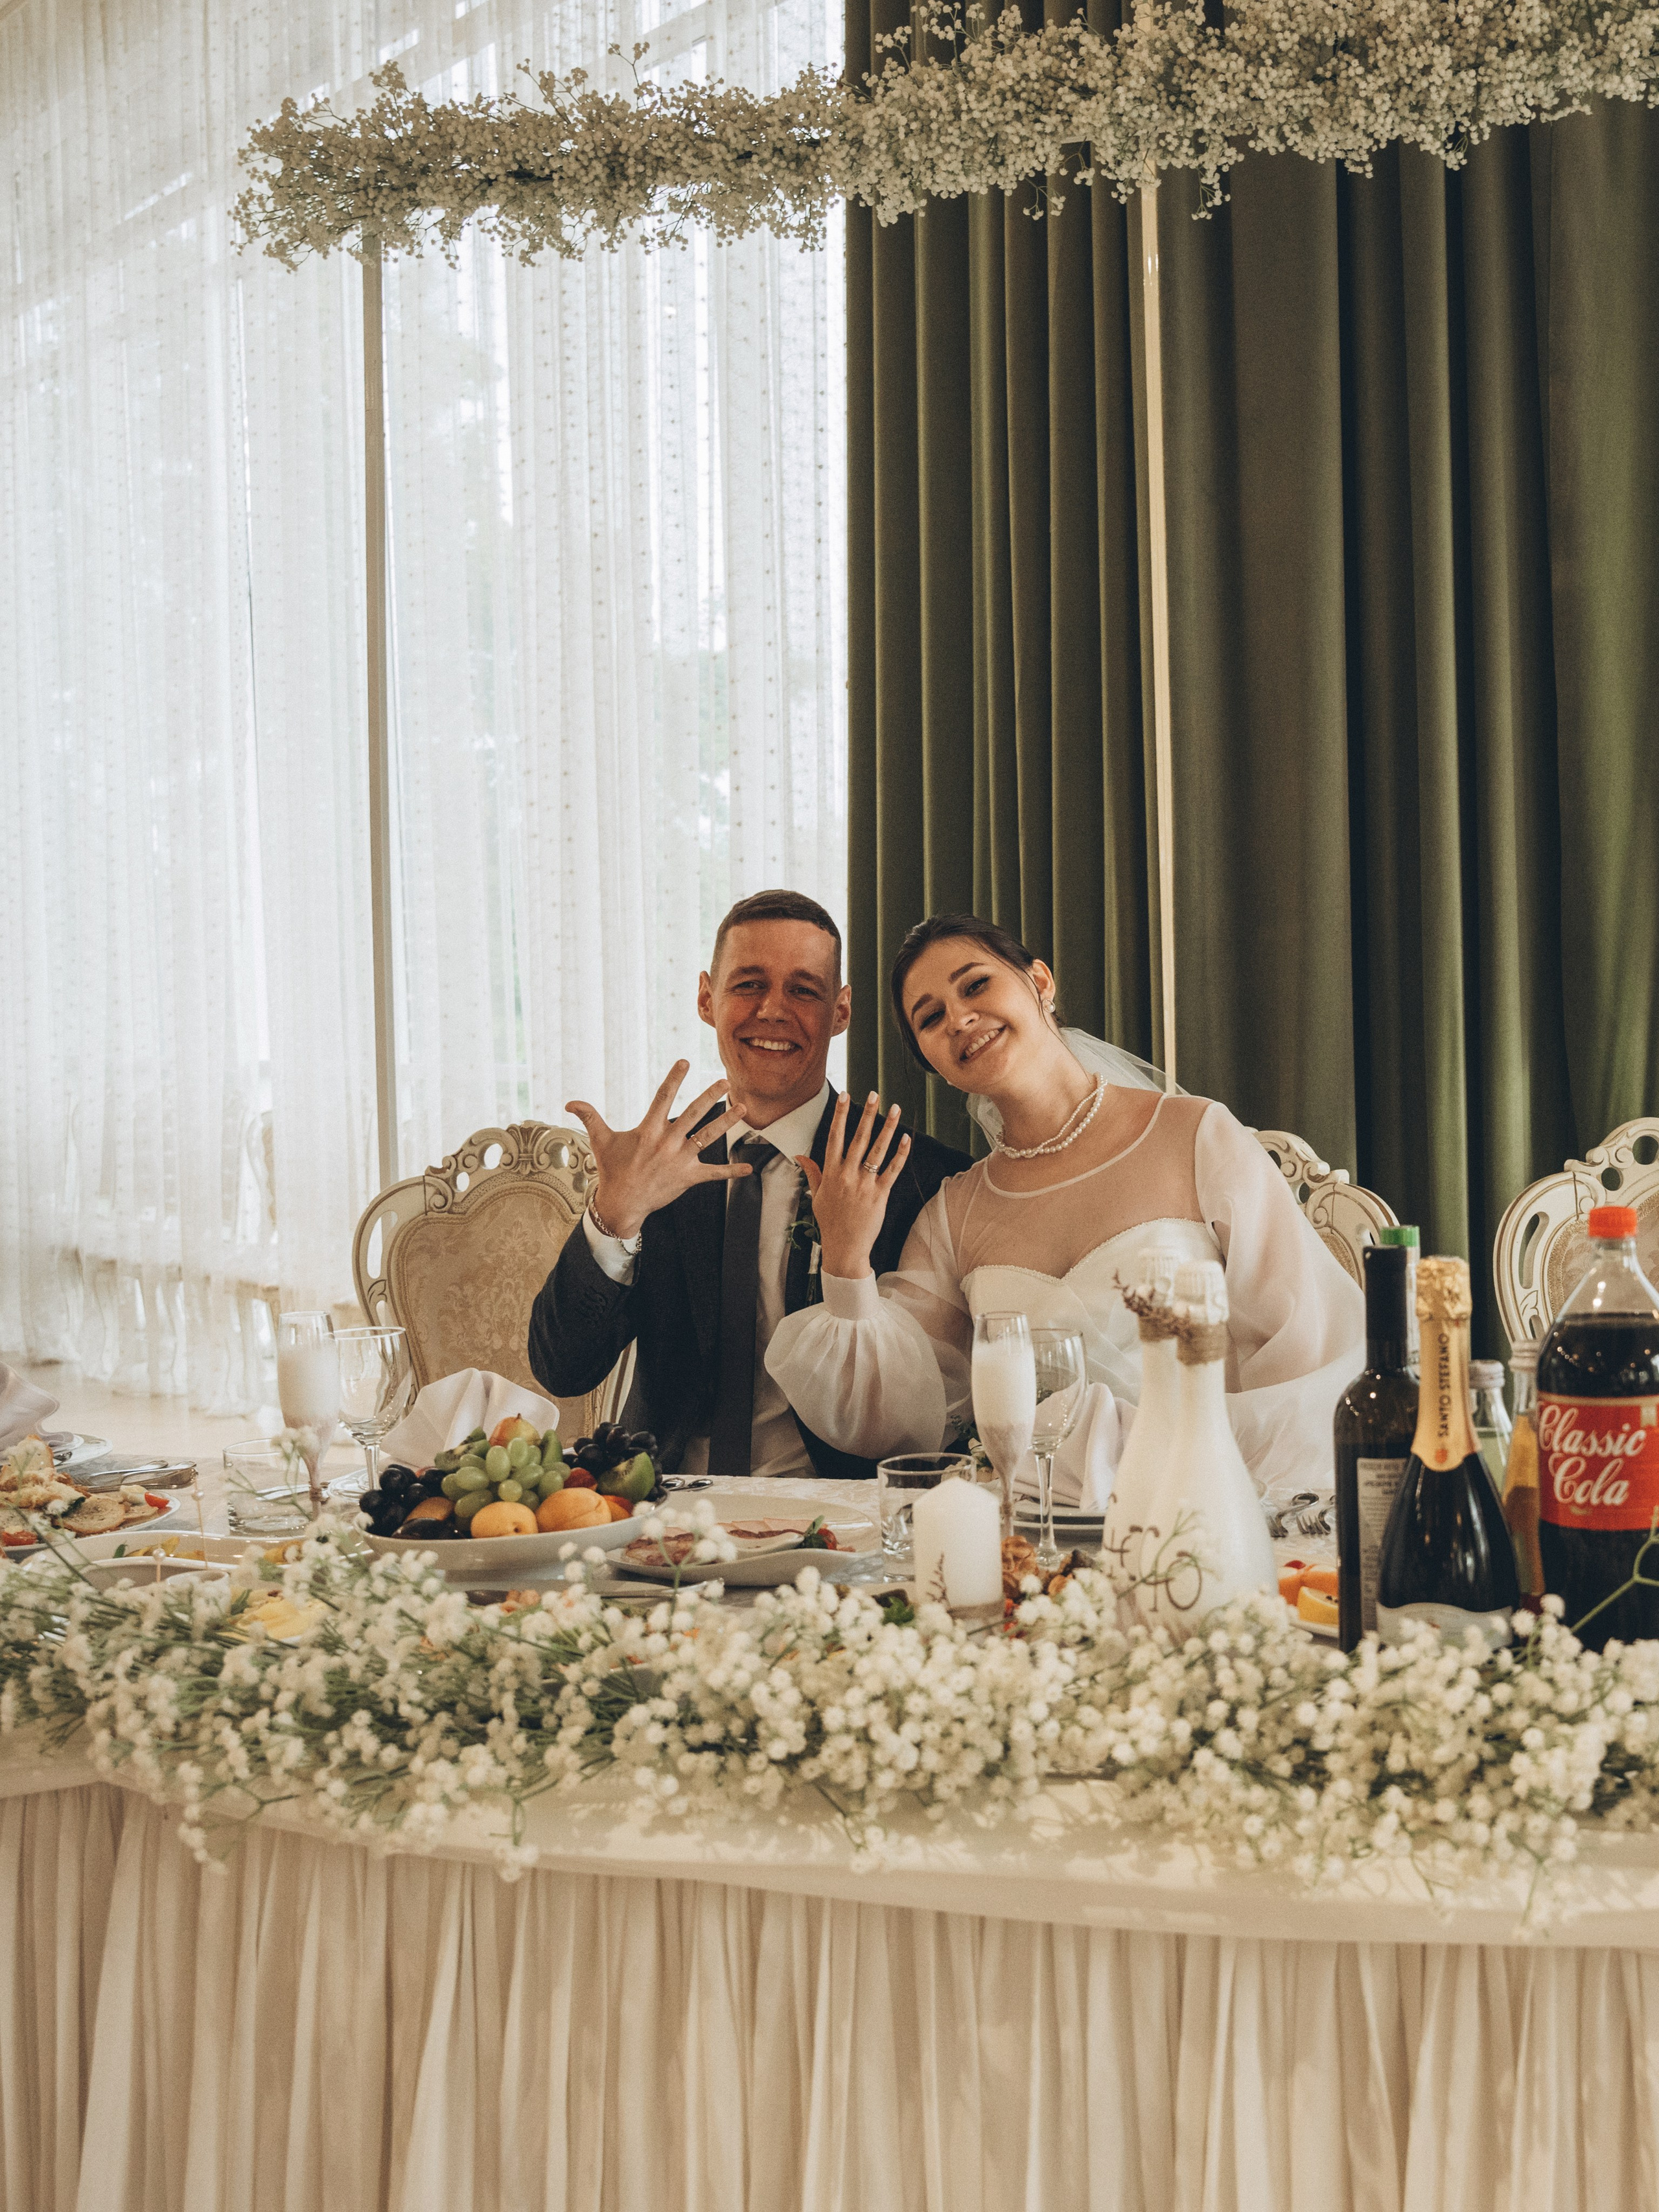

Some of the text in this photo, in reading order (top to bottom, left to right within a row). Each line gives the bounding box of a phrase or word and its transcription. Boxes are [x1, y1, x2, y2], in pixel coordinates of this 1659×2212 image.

[1437, 1333, 1451, 1438] SANTO STEFANO
[1537, 1402, 1647, 1457] Classic
[1548, 1452, 1630, 1506] Cola
